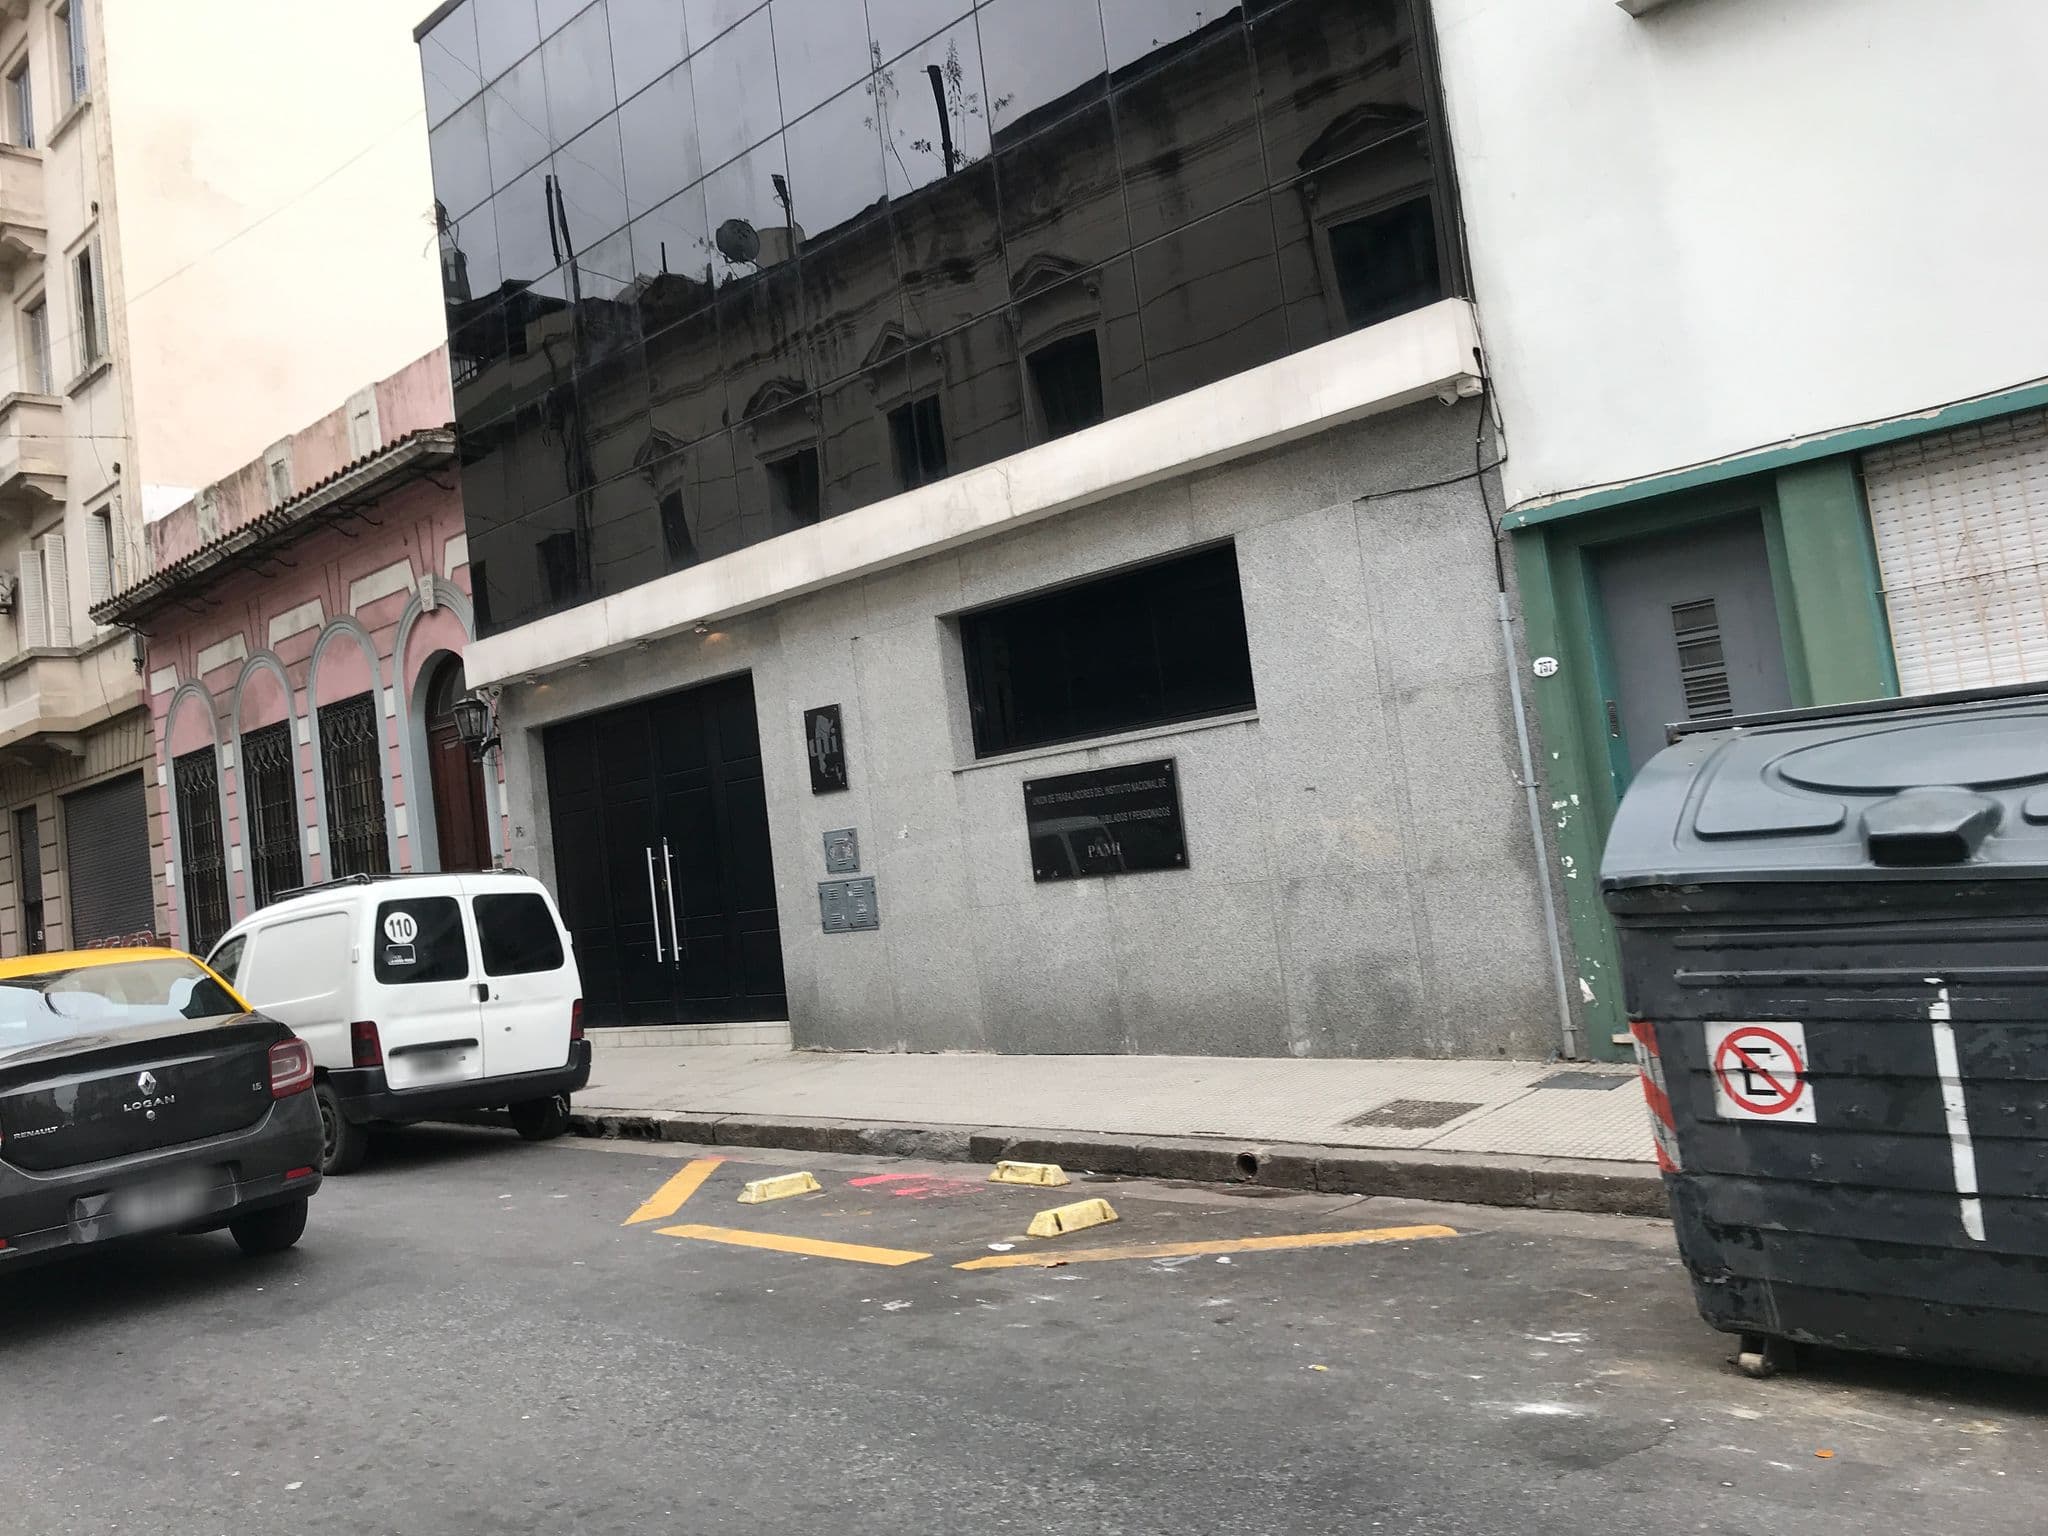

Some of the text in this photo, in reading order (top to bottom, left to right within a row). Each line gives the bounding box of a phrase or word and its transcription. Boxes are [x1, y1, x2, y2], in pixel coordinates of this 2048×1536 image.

[1087, 842, 1122, 858] PAMI
[389, 918, 412, 938] 110
[123, 1094, 176, 1113] LOGAN
[13, 1126, 58, 1140] RENAULT
